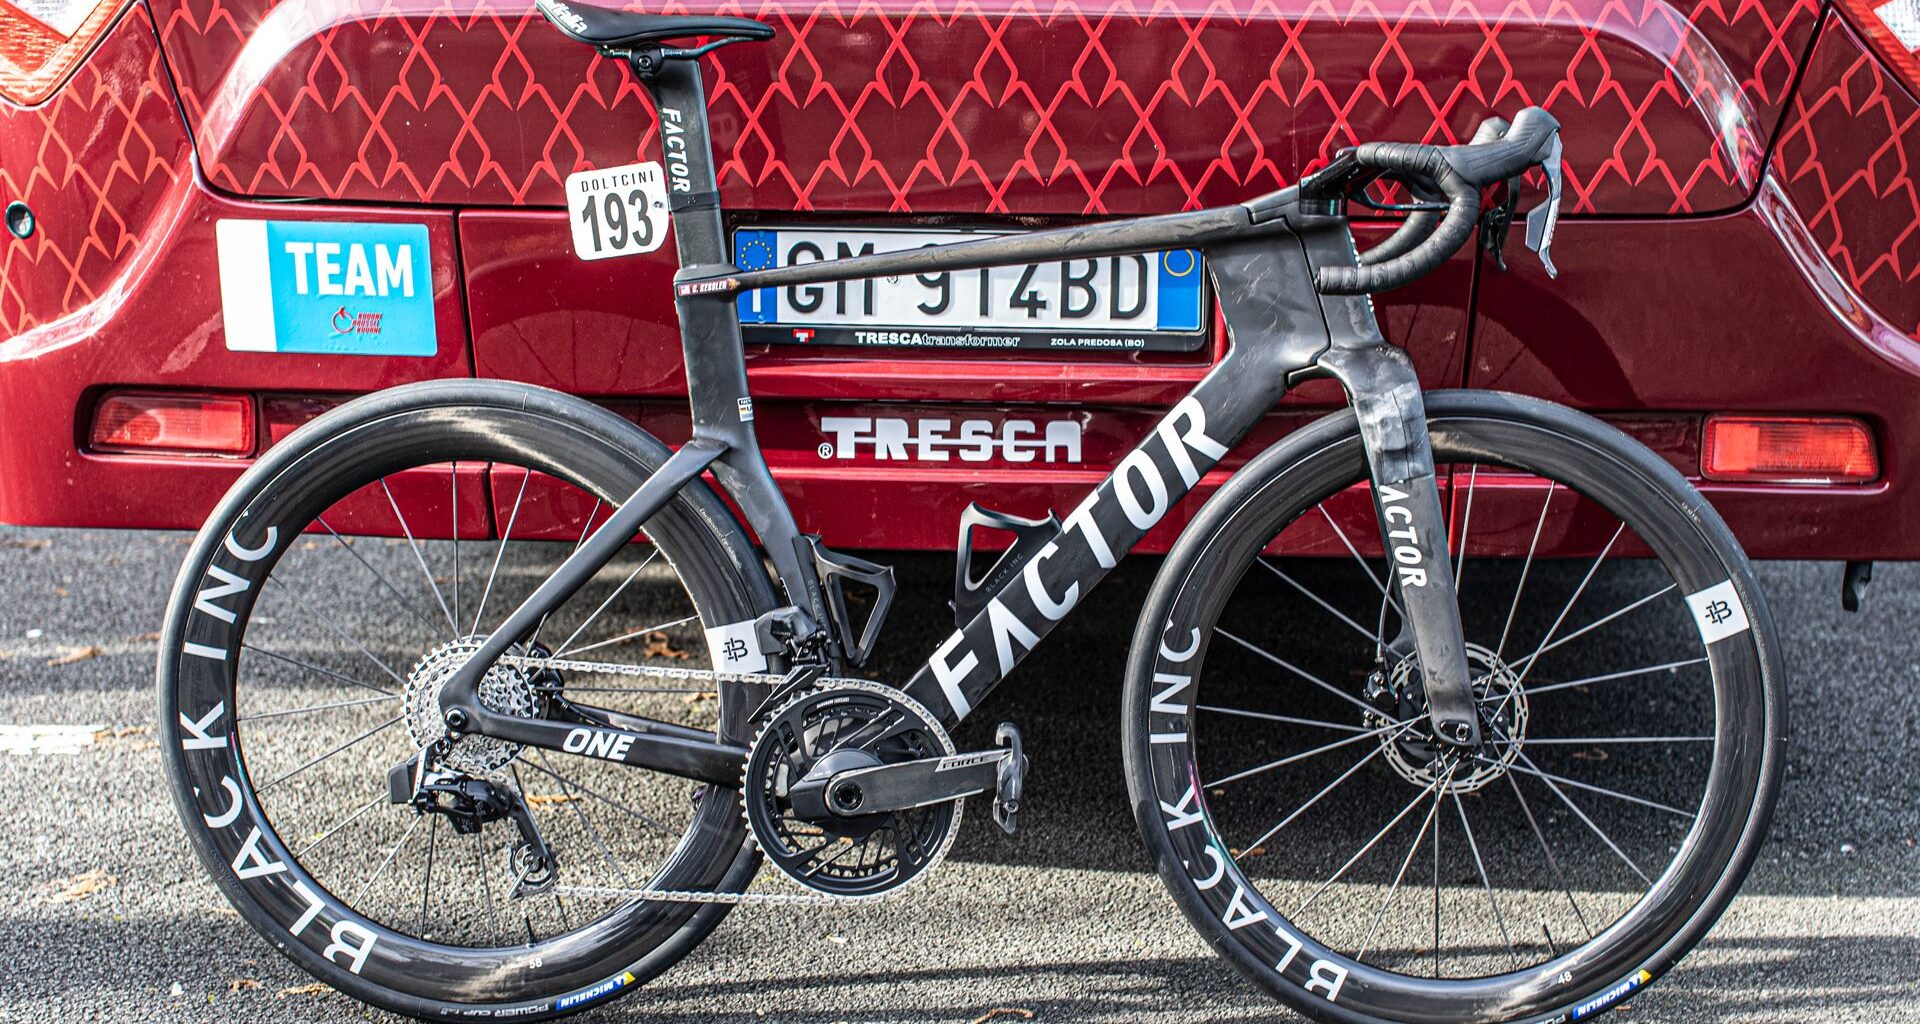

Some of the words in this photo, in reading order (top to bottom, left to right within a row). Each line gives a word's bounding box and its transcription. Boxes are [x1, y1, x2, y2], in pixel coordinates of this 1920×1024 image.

[663, 107, 691, 193] FACTOR
[581, 170, 654, 192] DOLTCINI
[582, 189, 653, 251] 193
[285, 242, 415, 297] TEAM
[787, 241, 875, 316] GM
[1051, 338, 1076, 346] ZOLA
[1078, 338, 1122, 347] PREDOSA
[1124, 338, 1145, 347] (BO)
[821, 417, 1082, 463] TRESCA
[1379, 480, 1427, 588] ACTOR
[929, 396, 1230, 722] FACTOR
[985, 567, 1009, 593] BLACK
[183, 510, 278, 660] INC
[1150, 620, 1202, 744] INC
[563, 728, 636, 761] ONE
[943, 757, 984, 769] FORCE
[180, 700, 378, 975] BLACK
[1159, 784, 1349, 1002] BLACK
[529, 958, 543, 969] 58
[1557, 970, 1573, 984] 48
[494, 1005, 549, 1017] POWER
[561, 981, 613, 1008] MICHELIN
[1577, 981, 1630, 1016] MICHELIN
